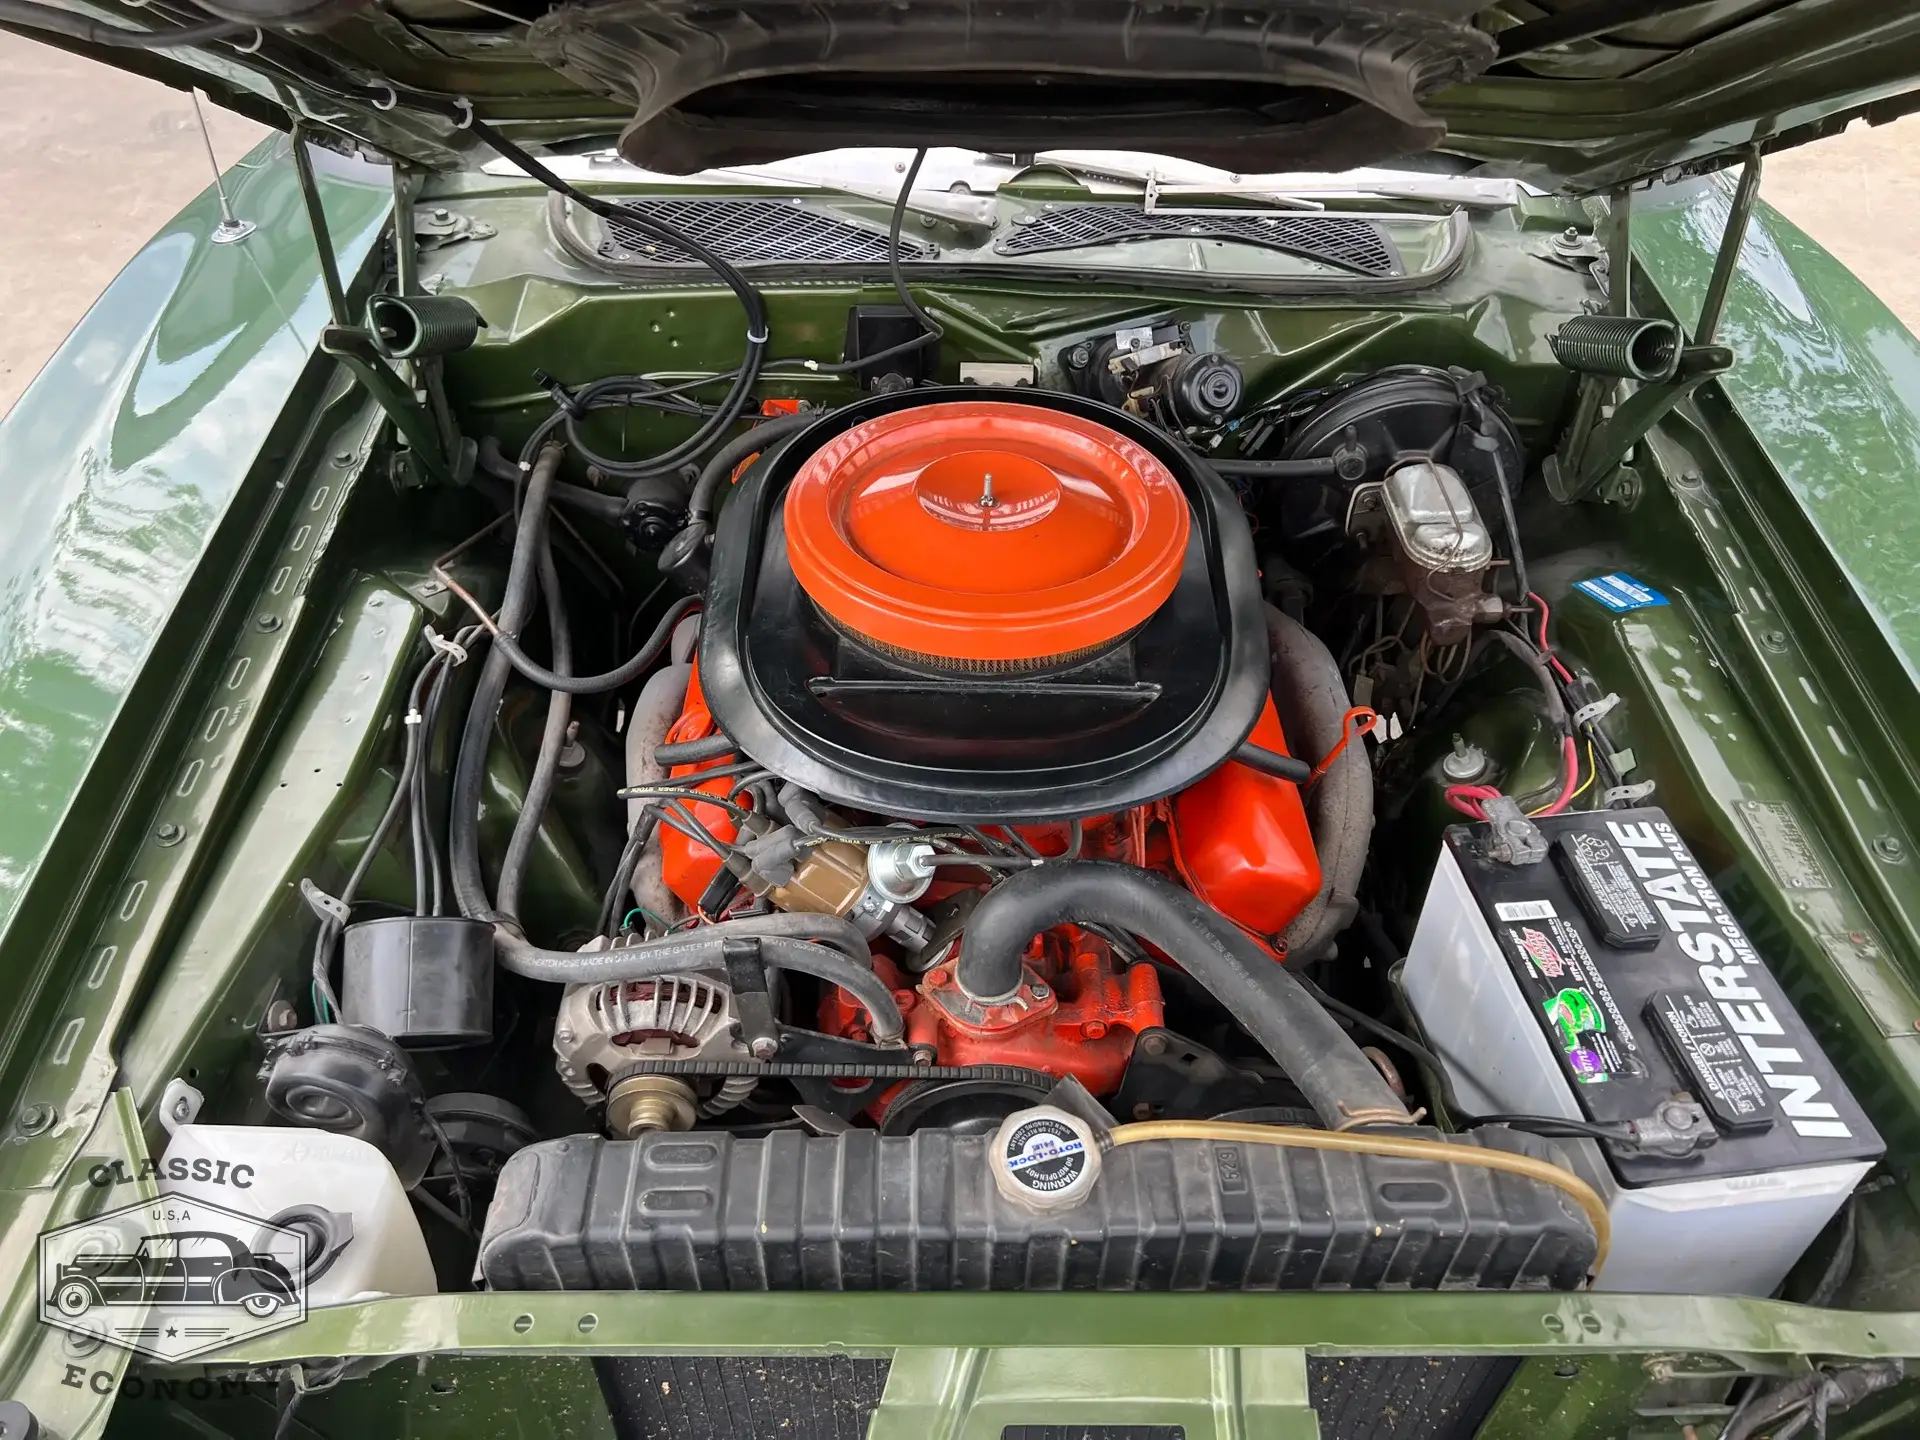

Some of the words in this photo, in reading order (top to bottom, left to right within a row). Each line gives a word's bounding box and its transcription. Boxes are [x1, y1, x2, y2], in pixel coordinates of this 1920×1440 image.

[1654, 822, 1693, 863] PLUS
[1682, 865, 1759, 965] MEGA-TRON
[653, 946, 672, 958] THE
[1605, 821, 1852, 1138] INTERSTATE
[1664, 1010, 1691, 1043] POISON
[1689, 1051, 1719, 1090] DANGER
[1065, 1157, 1073, 1167] DO
[1026, 1168, 1039, 1178] HOT
[1032, 1169, 1079, 1190] WARNING
[1040, 1172, 1058, 1181] OPEN
[1057, 1167, 1070, 1179] NOT
